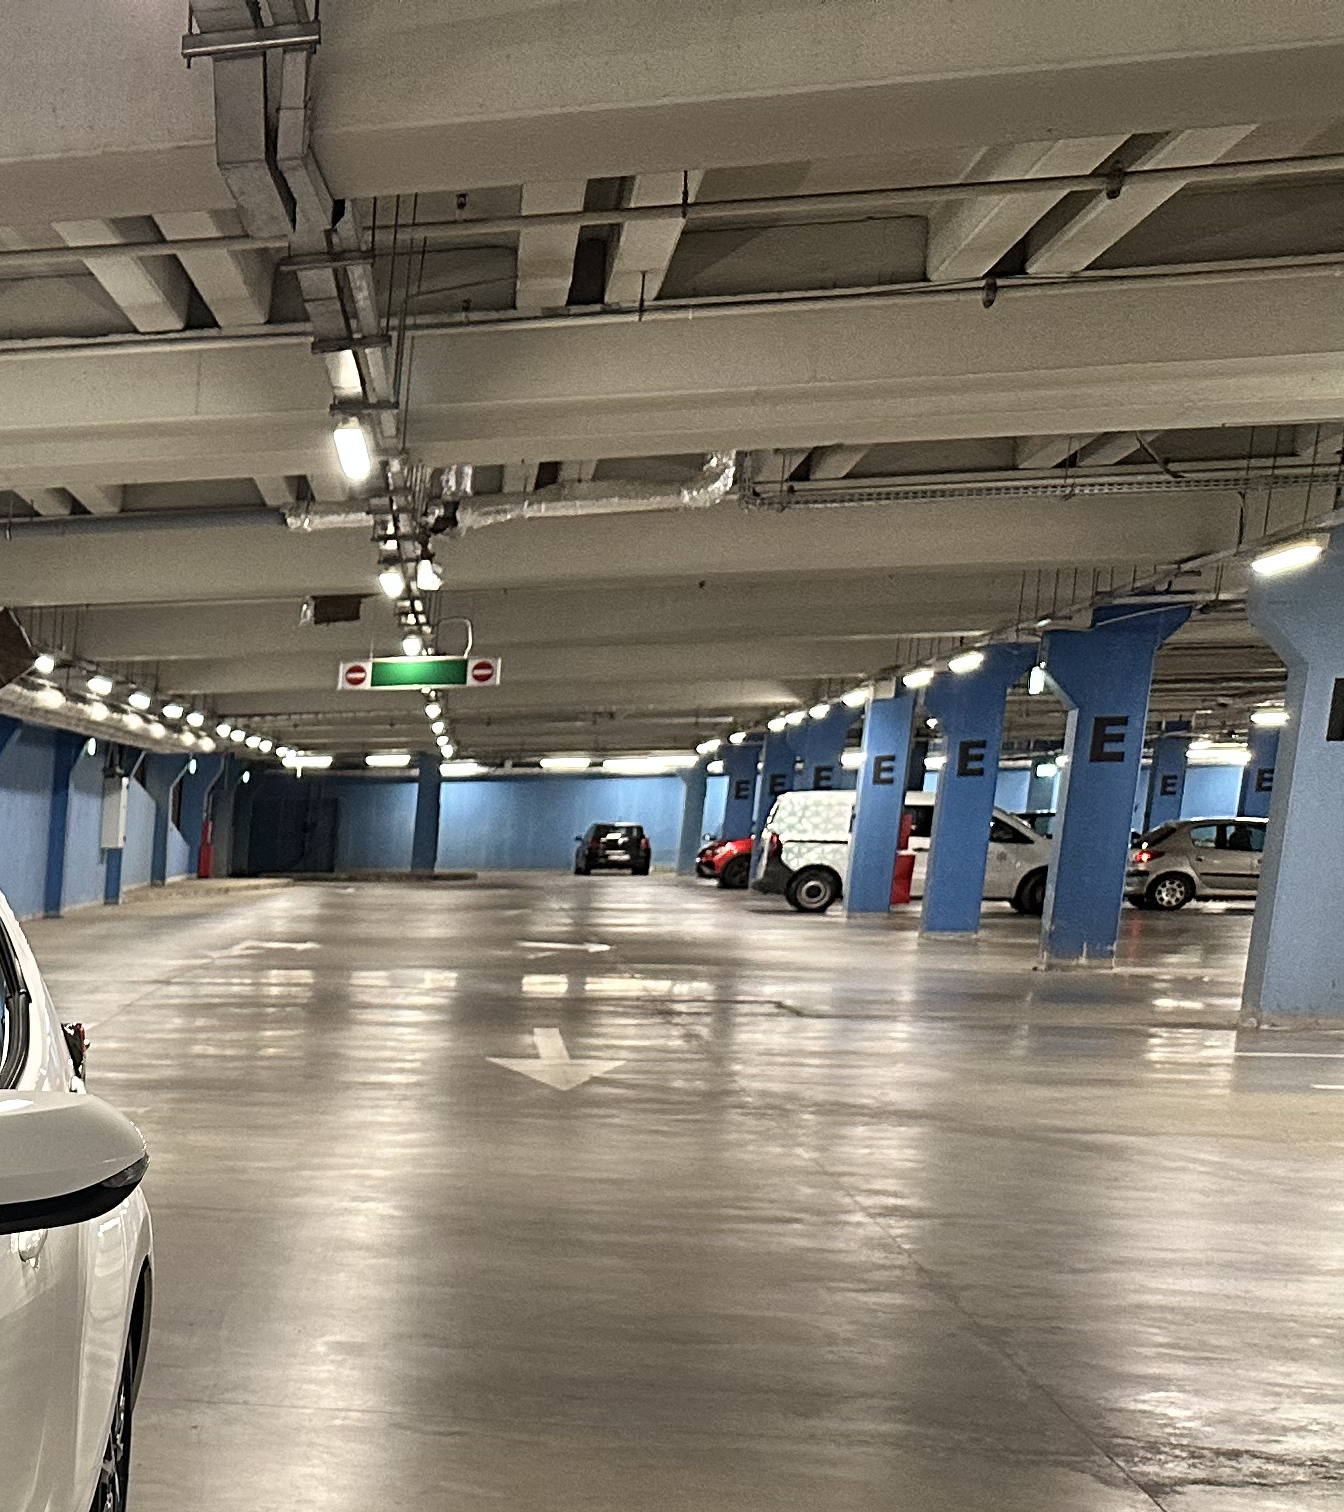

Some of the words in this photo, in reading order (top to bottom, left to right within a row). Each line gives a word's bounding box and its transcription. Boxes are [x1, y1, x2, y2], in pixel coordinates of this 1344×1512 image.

[1089, 716, 1128, 762] E
[957, 740, 986, 776] E
[814, 765, 834, 789] E
[873, 755, 896, 785] E
[1255, 769, 1274, 792] E
[734, 780, 750, 799] E
[769, 774, 788, 795] E
[1160, 775, 1177, 795] E
